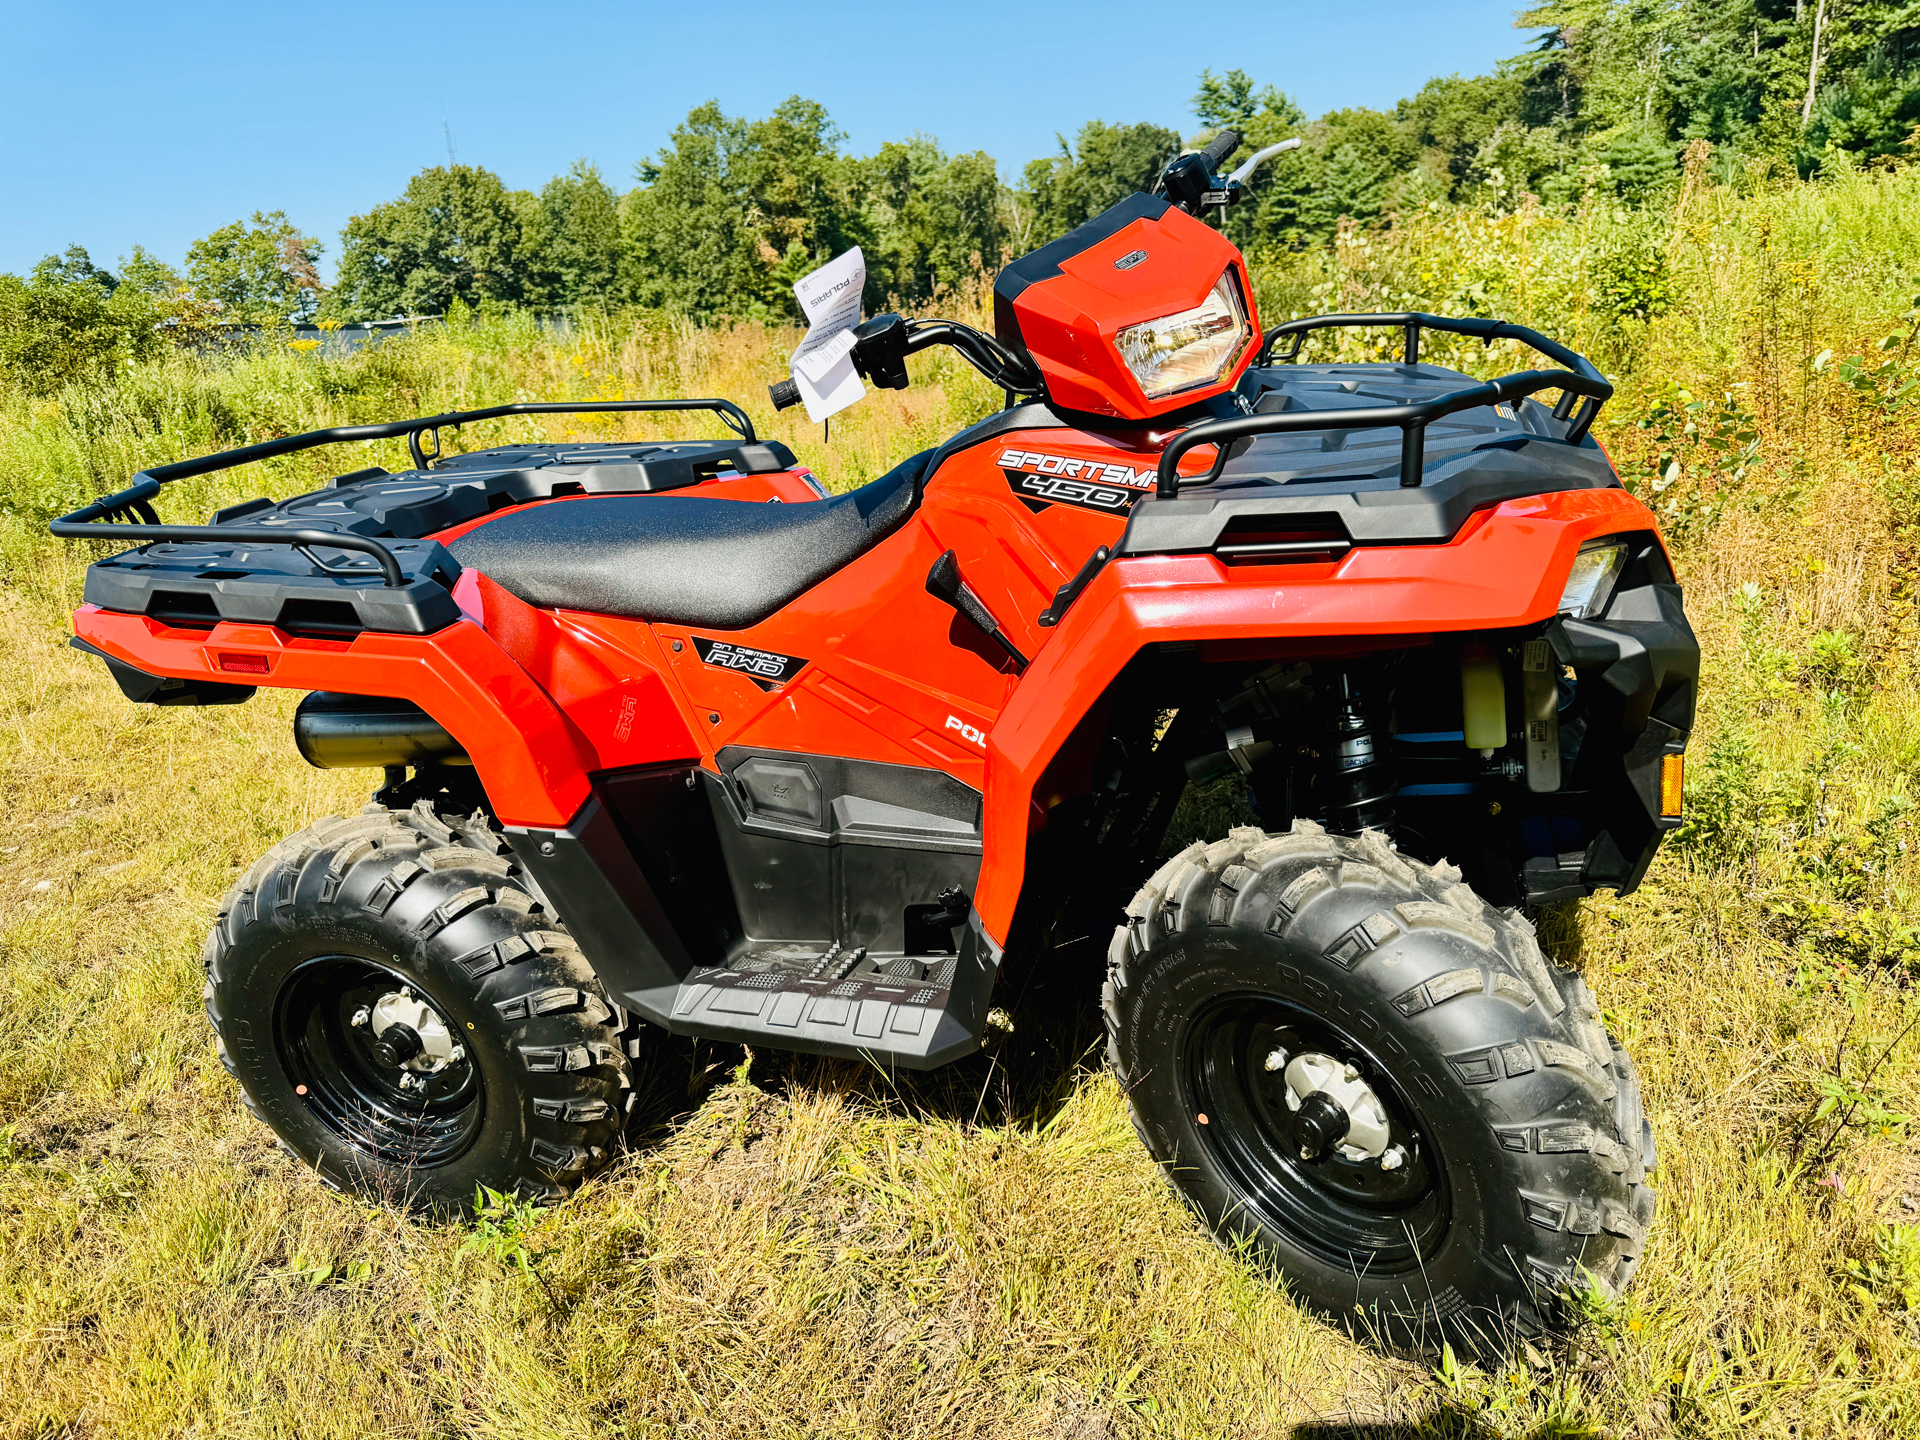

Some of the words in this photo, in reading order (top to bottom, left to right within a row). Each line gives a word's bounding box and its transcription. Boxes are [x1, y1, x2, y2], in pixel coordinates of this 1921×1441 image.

[811, 278, 850, 307] POLARIS
[1022, 475, 1129, 508] 450
[705, 649, 785, 677] AWD
[736, 647, 788, 663] DEMAND
[1344, 757, 1369, 767] SACHS
[1276, 961, 1445, 1101] POLARIS
